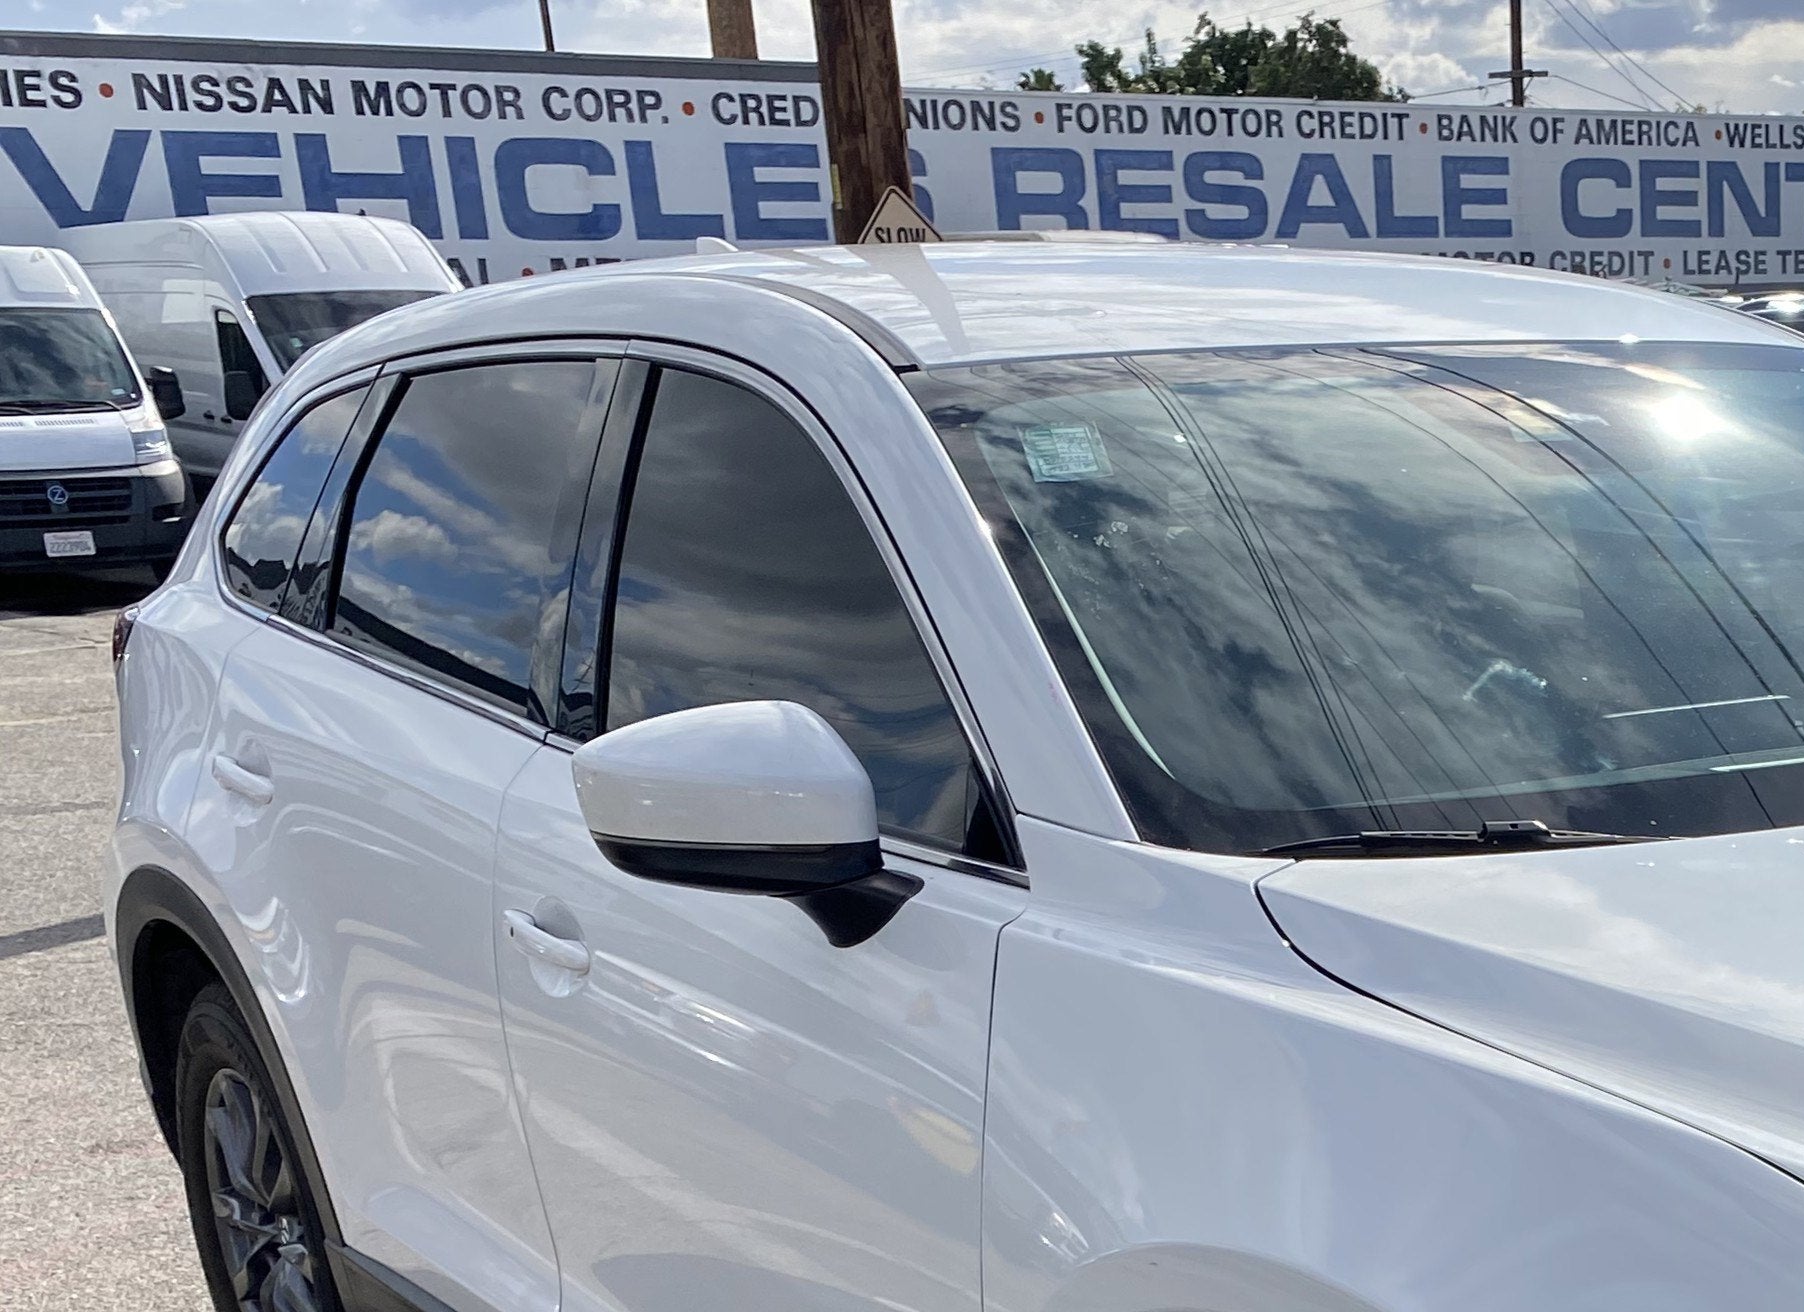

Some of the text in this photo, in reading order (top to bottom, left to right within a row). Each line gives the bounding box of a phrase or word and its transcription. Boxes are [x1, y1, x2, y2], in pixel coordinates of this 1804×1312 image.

[131, 72, 335, 115] NISSAN
[350, 79, 525, 120] MOTOR
[541, 86, 669, 124] CORP.
[1055, 102, 1148, 135] FORD
[1162, 106, 1284, 138] MOTOR
[1296, 109, 1410, 141] CREDIT
[1437, 113, 1518, 144] BANK
[1530, 116, 1565, 145] OF
[1574, 118, 1700, 148] AMERICA
[990, 147, 1513, 240] RESALE
[1550, 250, 1655, 277] CREDIT
[1683, 250, 1768, 276] LEASE
